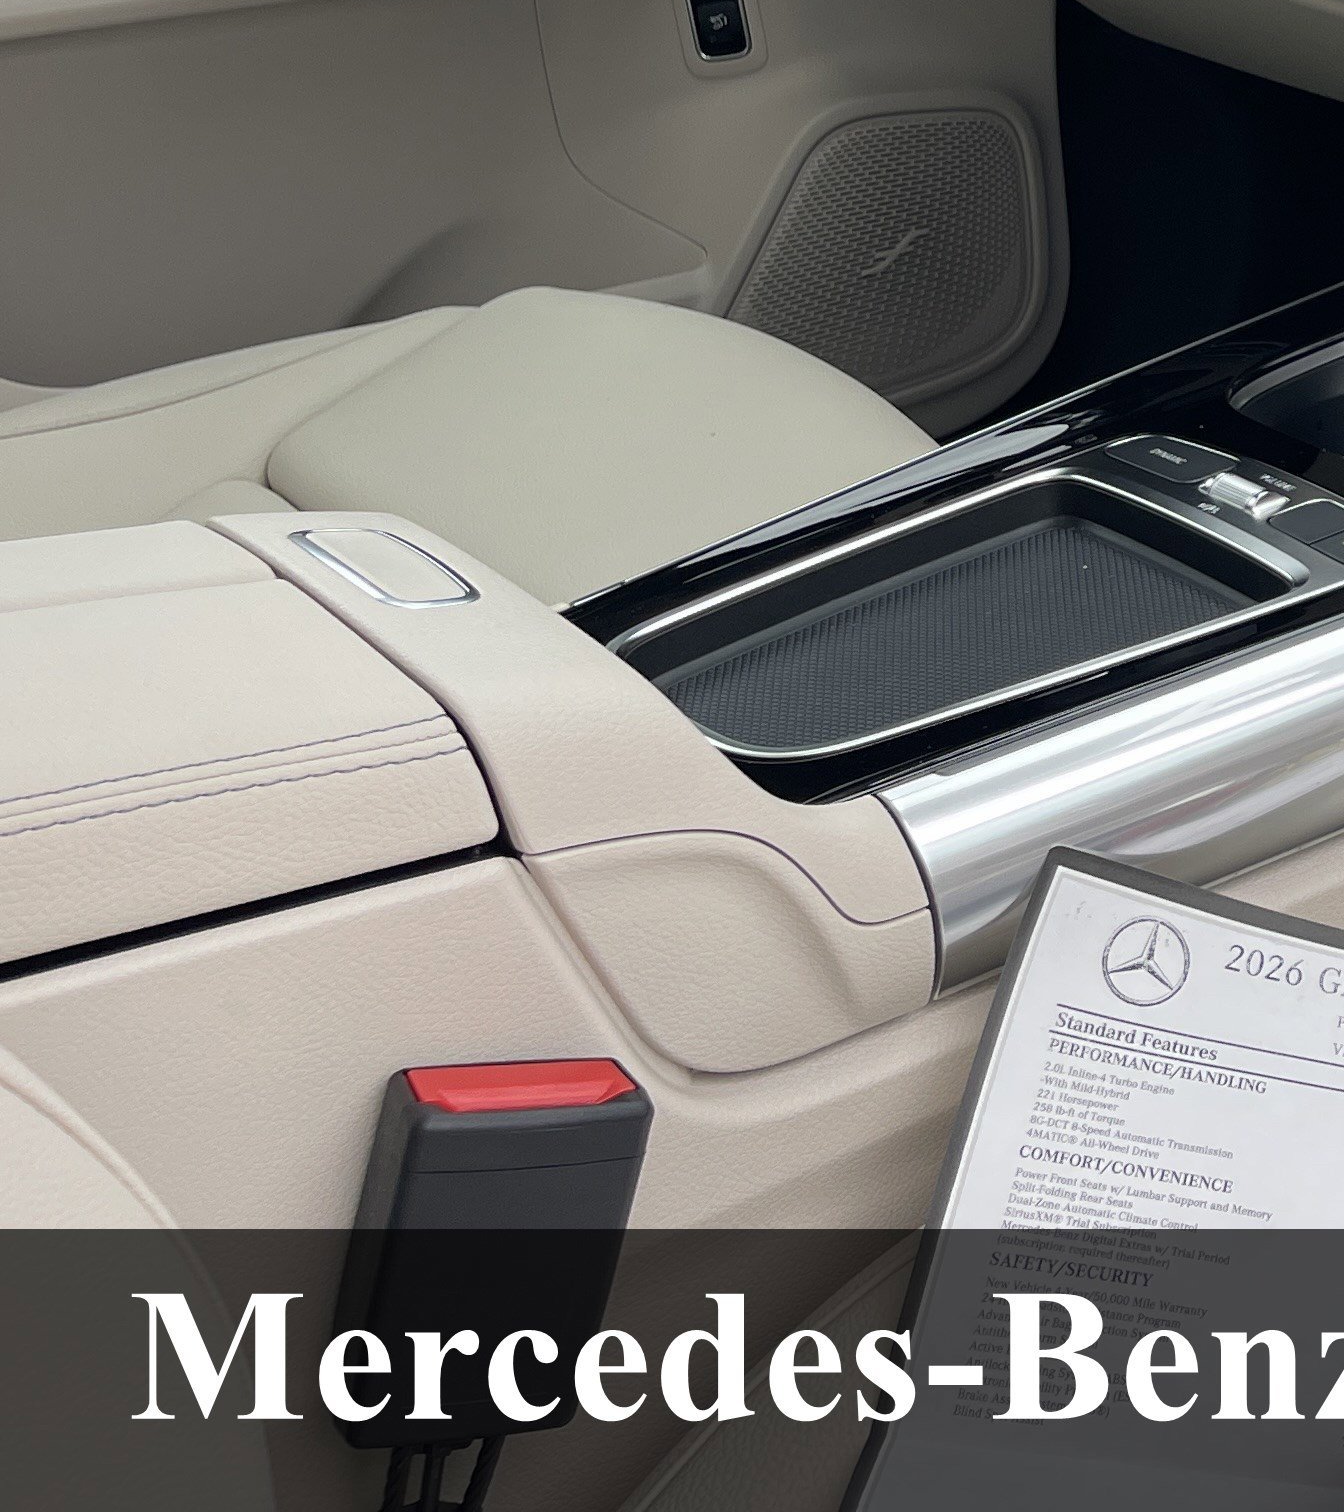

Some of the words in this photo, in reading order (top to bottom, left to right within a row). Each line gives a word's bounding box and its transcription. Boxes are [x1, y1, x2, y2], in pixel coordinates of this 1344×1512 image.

[1224, 944, 1303, 987] 2026
[1056, 1012, 1136, 1044] Standard
[1140, 1032, 1218, 1060] Features
[1050, 1038, 1267, 1094] PERFORMANCE/HANDLING
[1020, 1144, 1233, 1193] COMFORT/CONVENIENCE
